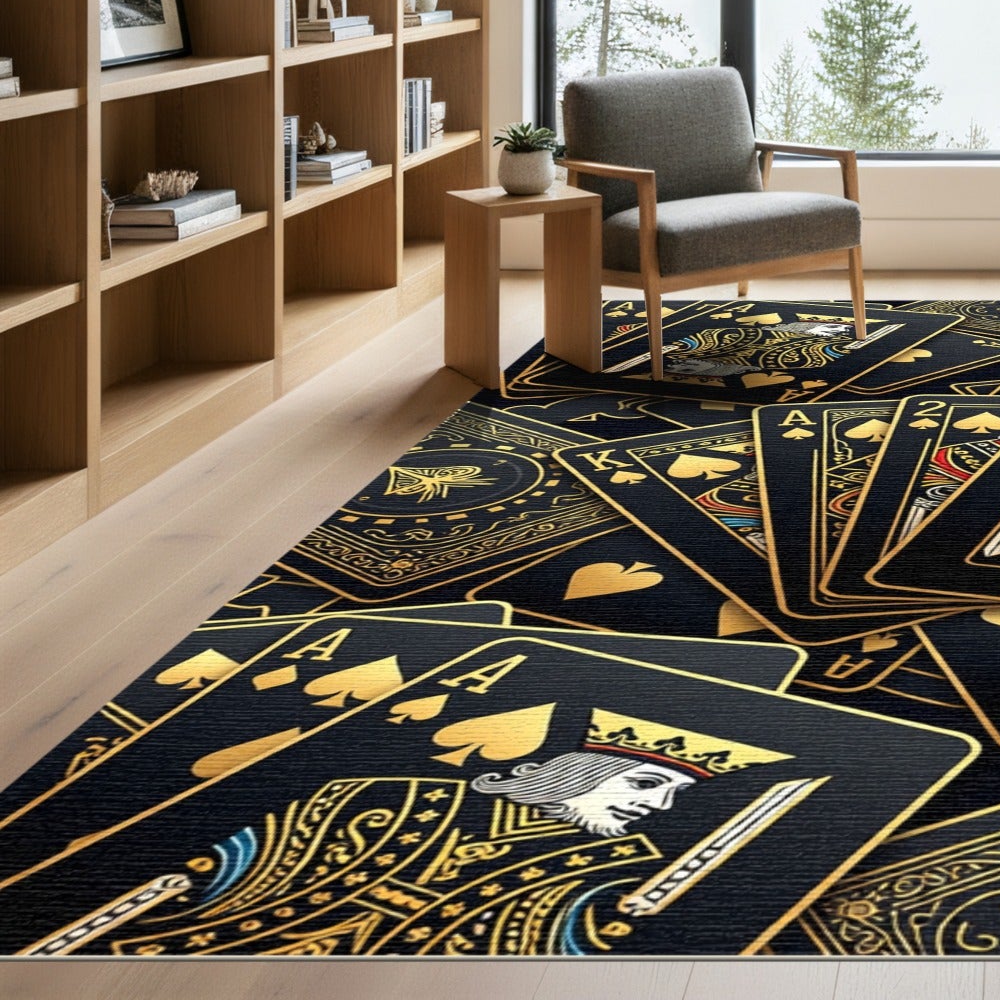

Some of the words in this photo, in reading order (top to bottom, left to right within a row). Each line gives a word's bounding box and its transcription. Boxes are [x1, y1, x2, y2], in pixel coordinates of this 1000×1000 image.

[610, 302, 635, 310] A
[724, 303, 755, 312] A
[776, 389, 815, 402] A
[913, 401, 947, 416] 2
[778, 409, 817, 426] A
[576, 449, 634, 471] K
[281, 628, 352, 661] A
[439, 655, 528, 694] A
[824, 654, 875, 679] A
